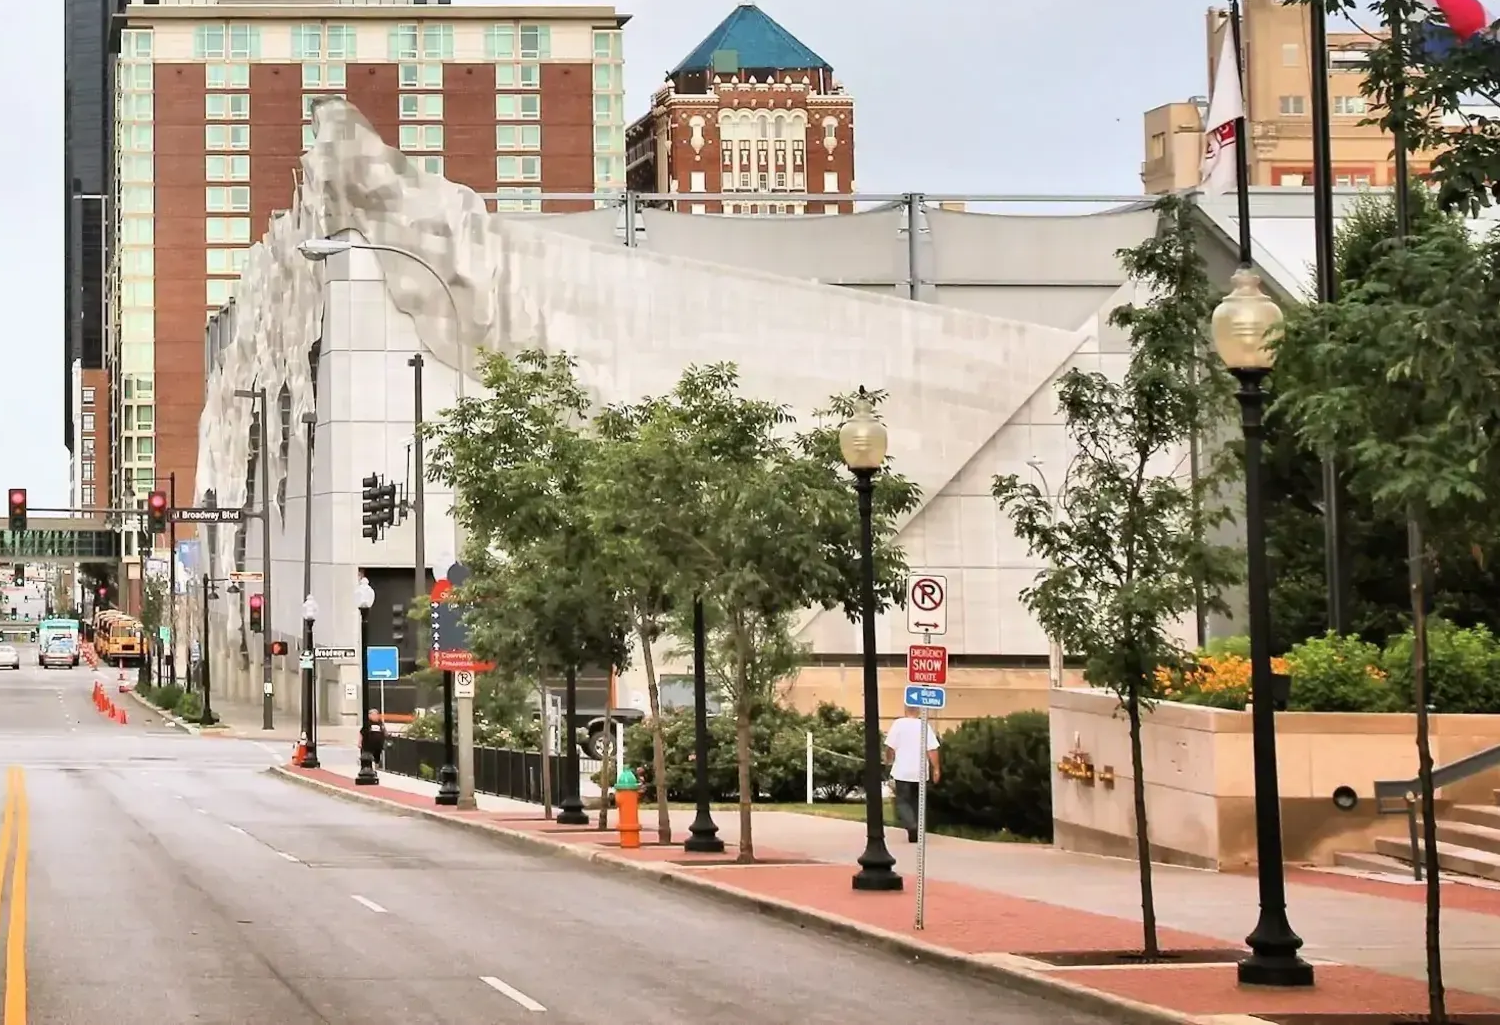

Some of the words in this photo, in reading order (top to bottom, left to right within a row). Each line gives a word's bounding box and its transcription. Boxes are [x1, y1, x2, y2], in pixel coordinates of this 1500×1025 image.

[182, 510, 219, 521] Broadway
[221, 511, 239, 519] Blvd
[315, 648, 344, 659] Broadway
[911, 647, 944, 658] EMERGENCY
[912, 658, 942, 672] SNOW
[914, 672, 937, 682] ROUTE
[921, 689, 936, 698] BUS
[922, 697, 941, 706] TURN
